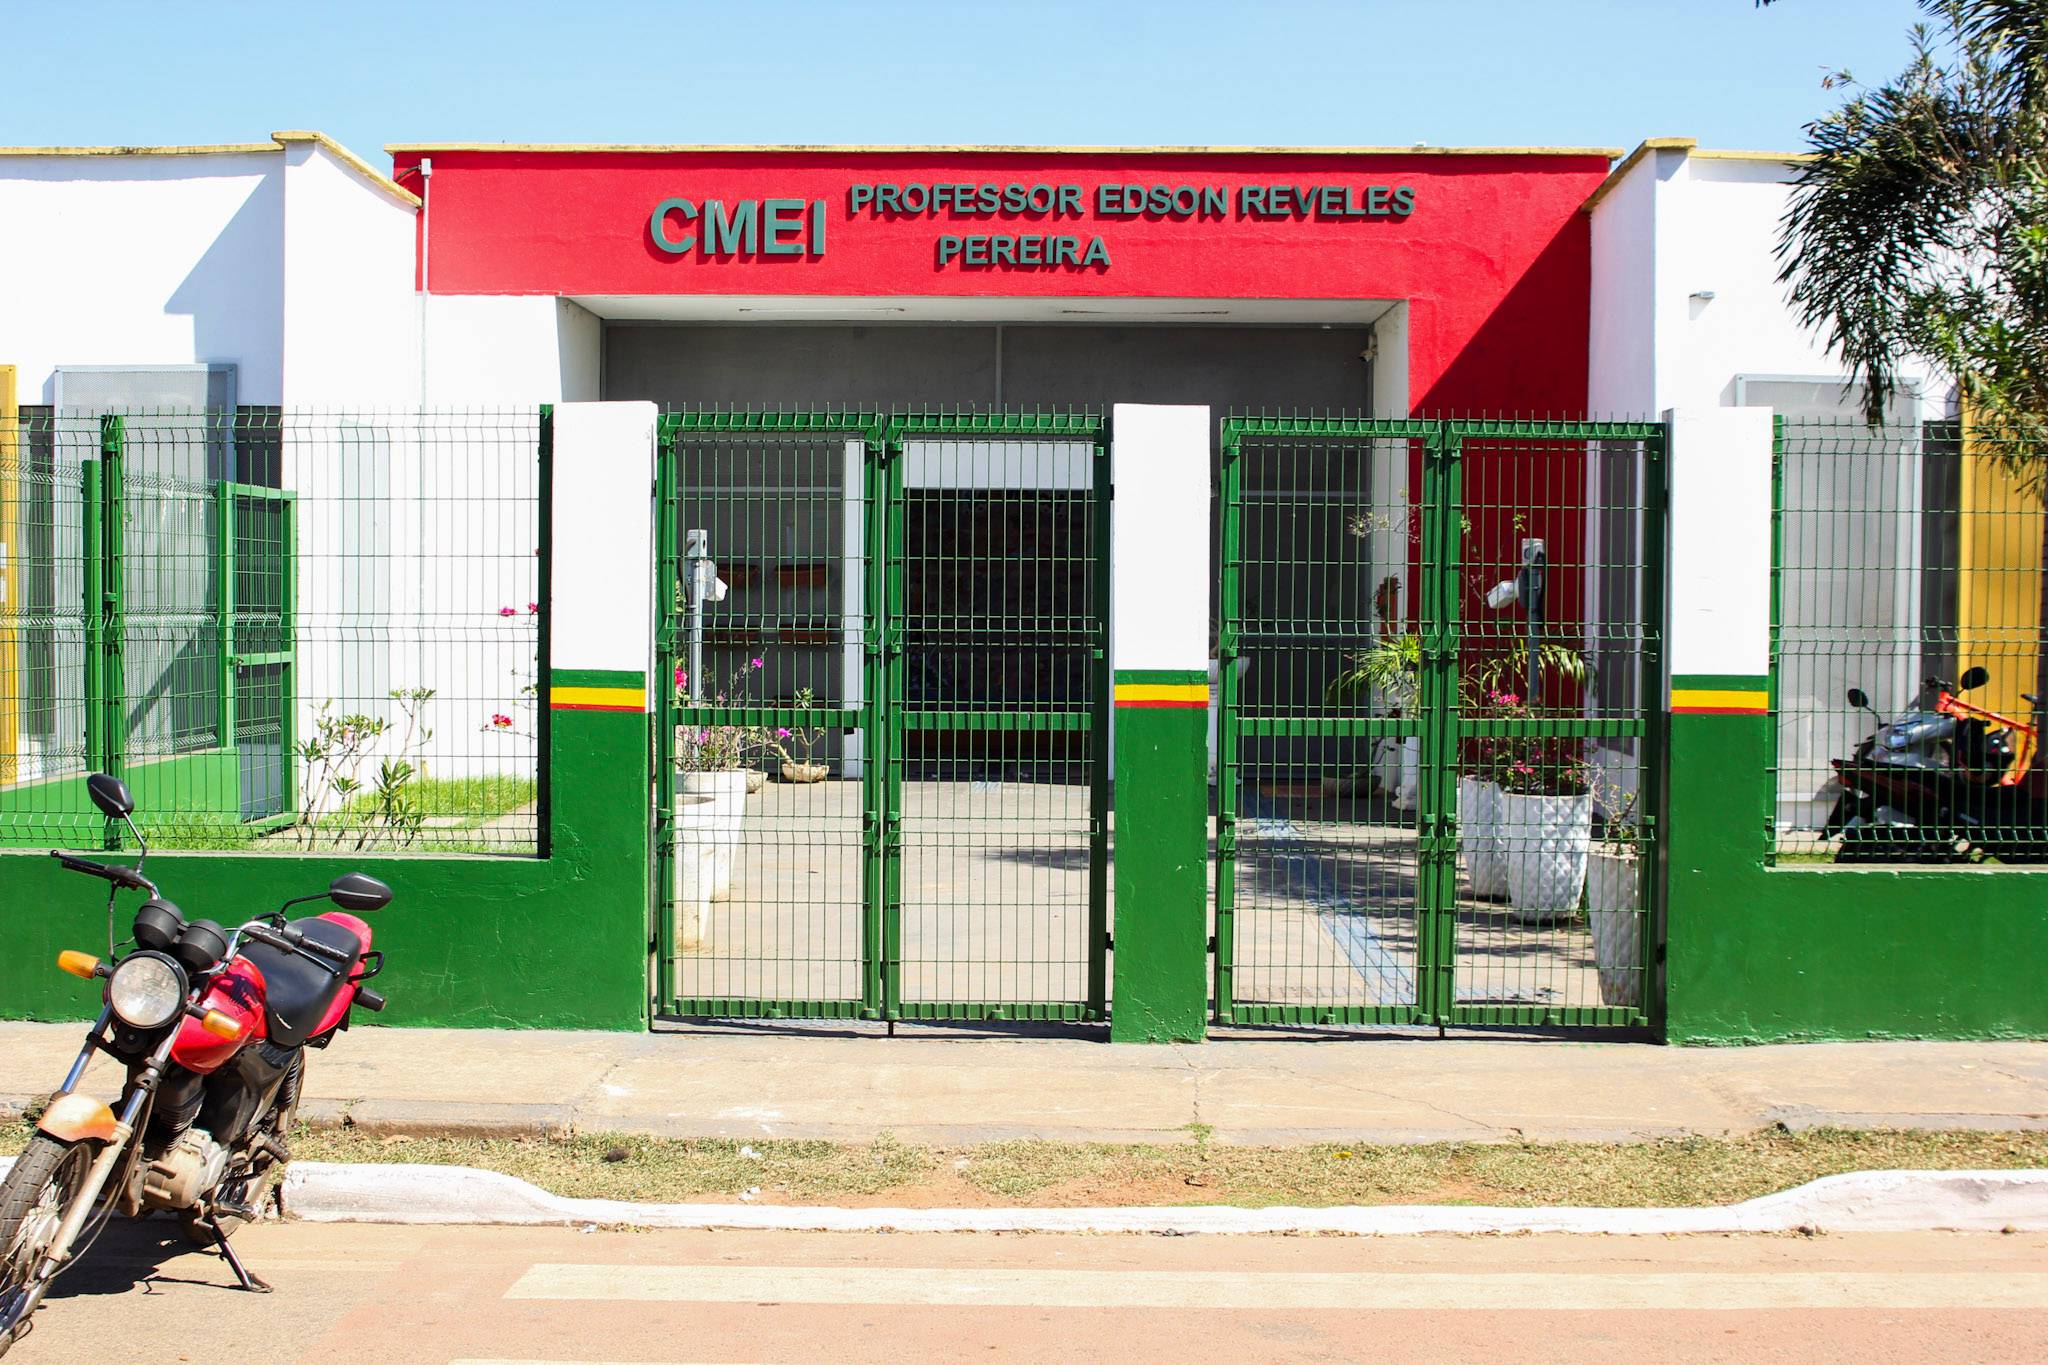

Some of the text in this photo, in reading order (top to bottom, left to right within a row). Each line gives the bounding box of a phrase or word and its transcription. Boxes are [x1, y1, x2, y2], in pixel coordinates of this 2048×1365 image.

[851, 183, 1415, 215] PROFESSOR EDSON REVELES
[651, 197, 826, 255] CMEI
[939, 235, 1111, 265] PEREIRA
